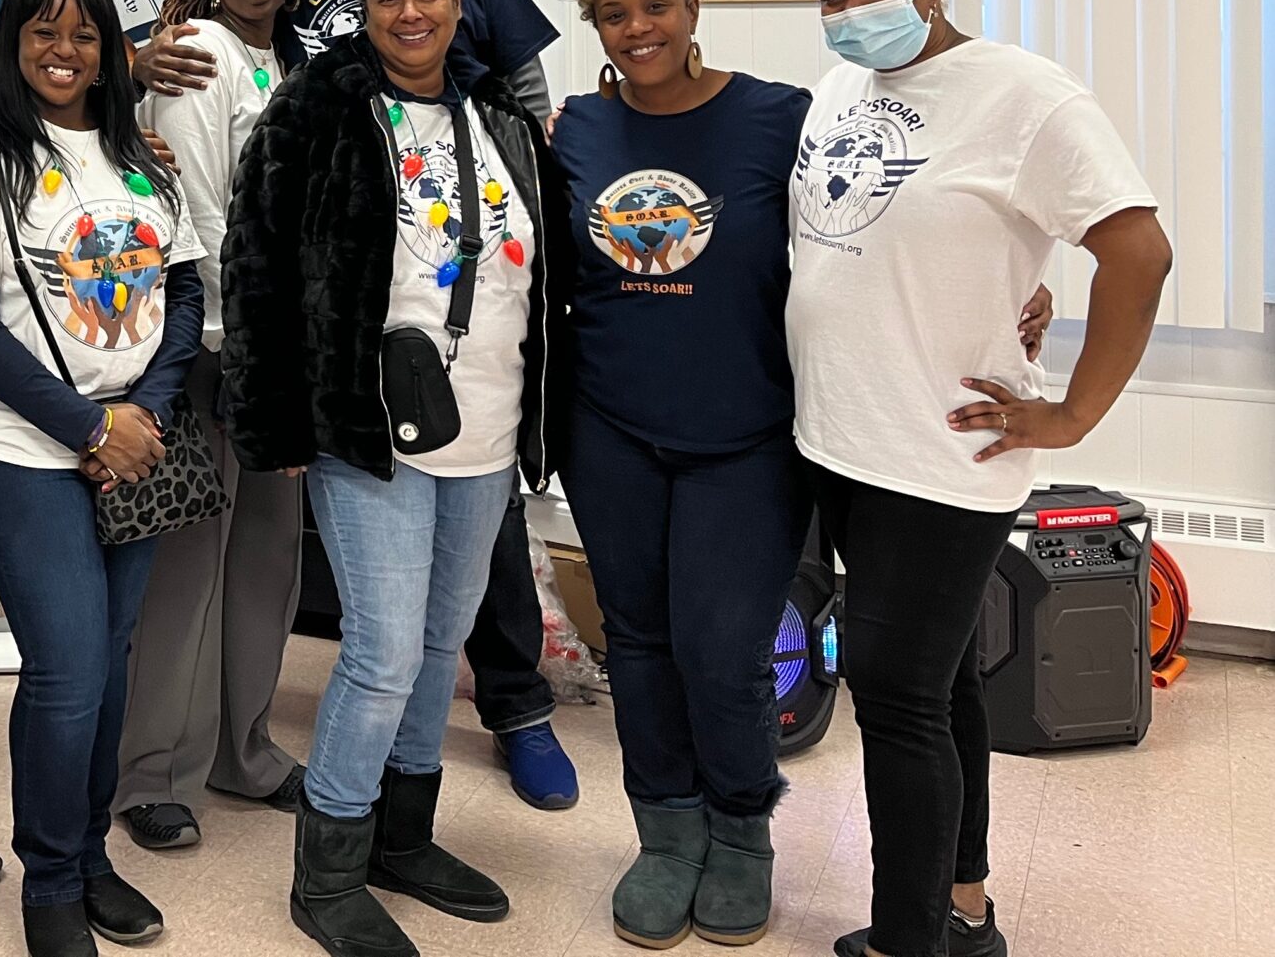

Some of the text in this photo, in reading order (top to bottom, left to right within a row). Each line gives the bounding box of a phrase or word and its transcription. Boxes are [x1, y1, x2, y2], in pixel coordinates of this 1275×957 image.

[880, 97, 925, 132] SOAR!
[399, 145, 432, 163] ET'S
[626, 210, 671, 222] S.O.A.R.
[653, 283, 694, 295] SOAR!!
[1057, 513, 1112, 525] MONSTER
